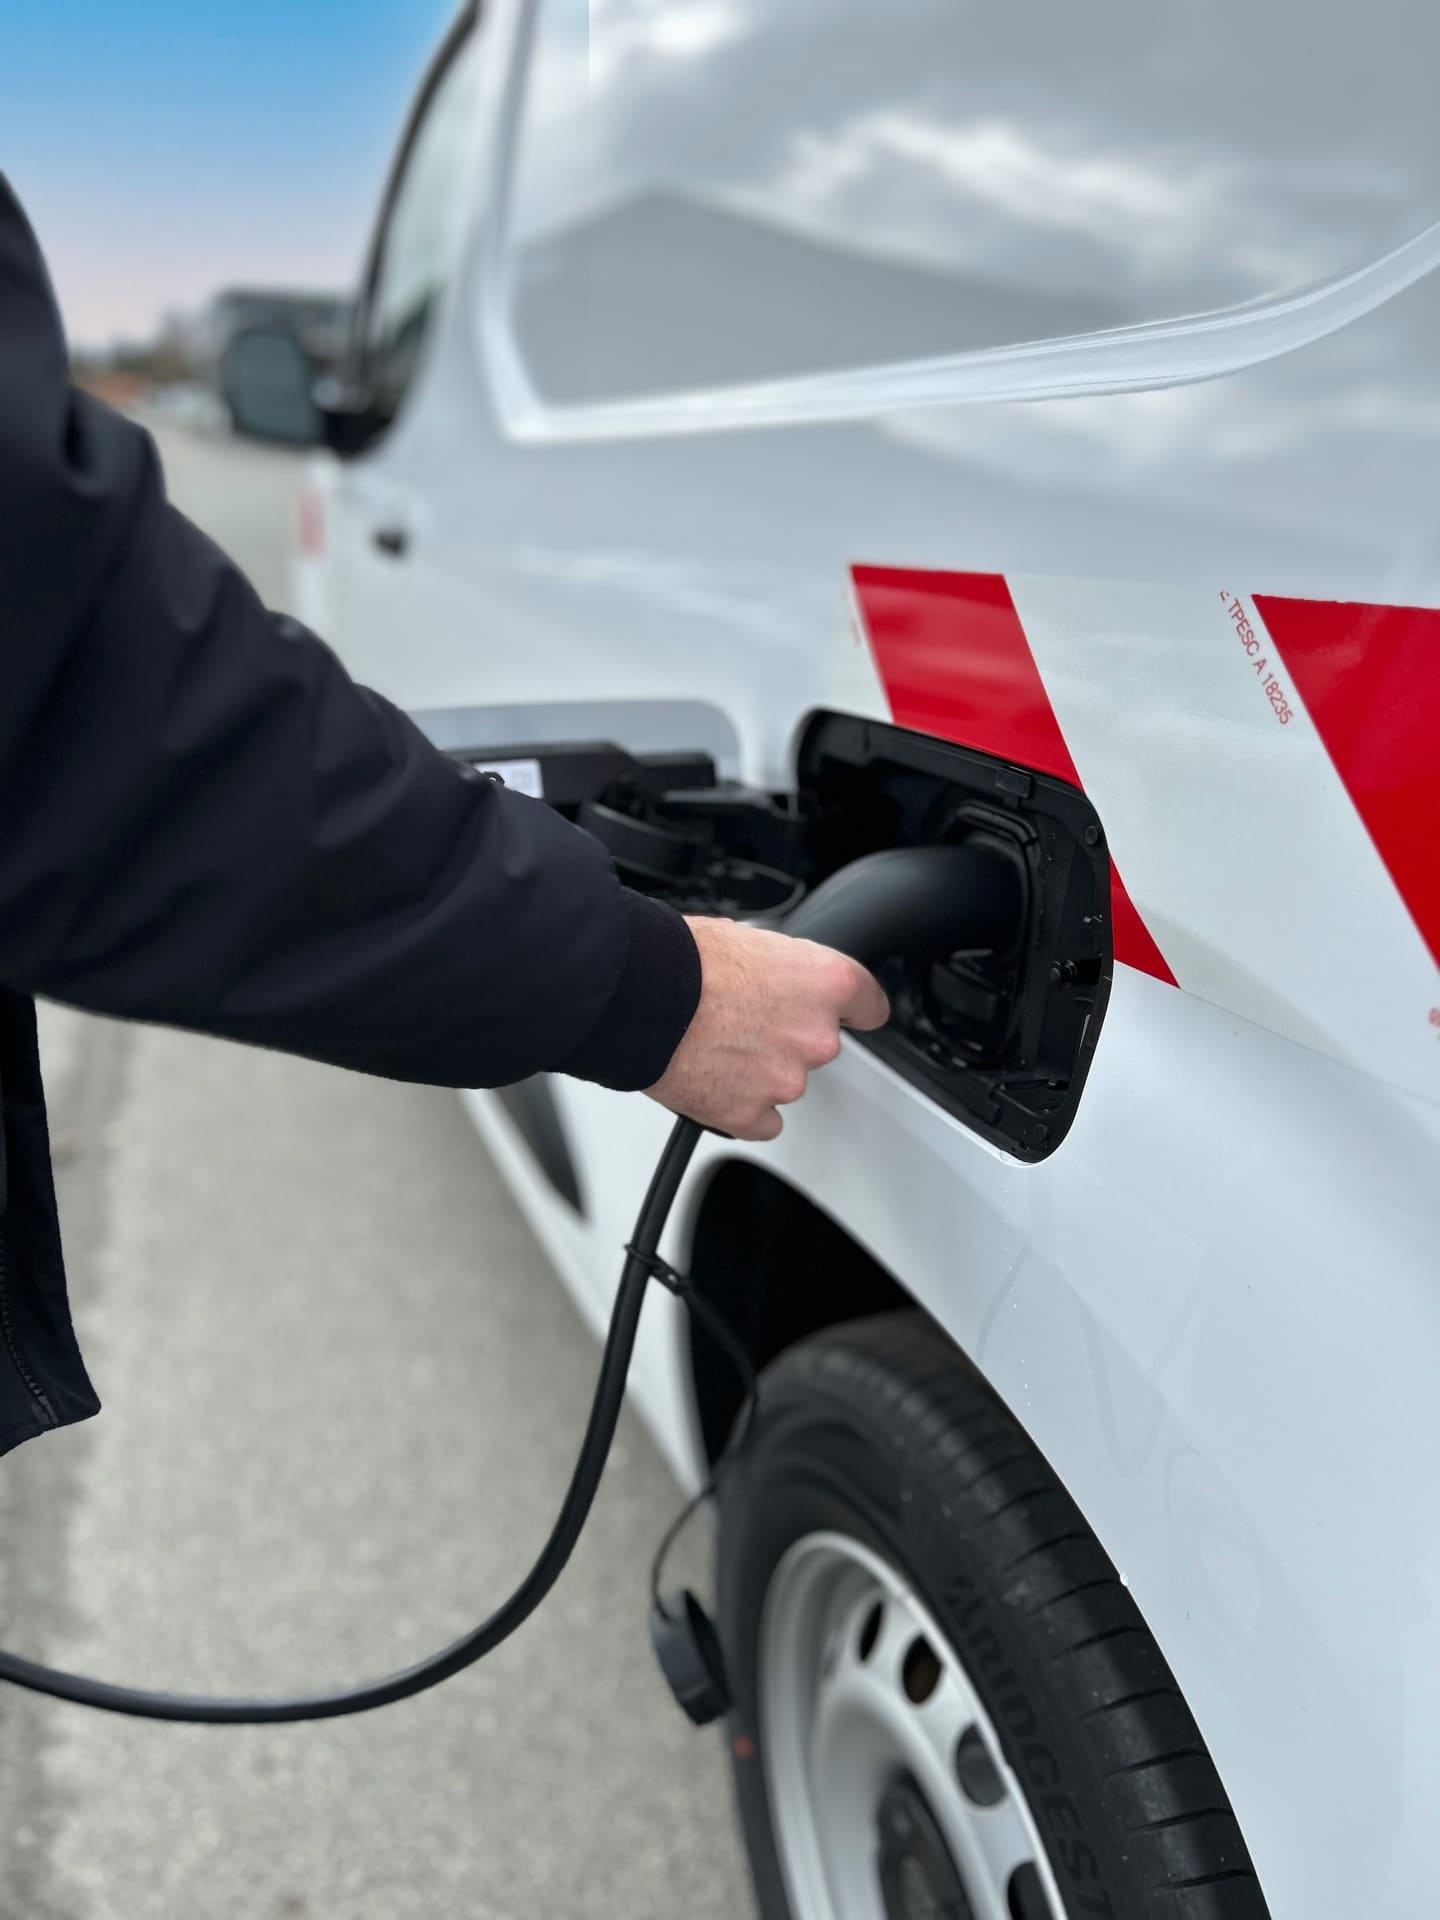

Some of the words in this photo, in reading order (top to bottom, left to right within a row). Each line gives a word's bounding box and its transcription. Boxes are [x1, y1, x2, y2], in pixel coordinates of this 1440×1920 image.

[1228, 598, 1260, 656] TPESC
[1252, 658, 1266, 675] A
[1262, 672, 1293, 724] 18235
